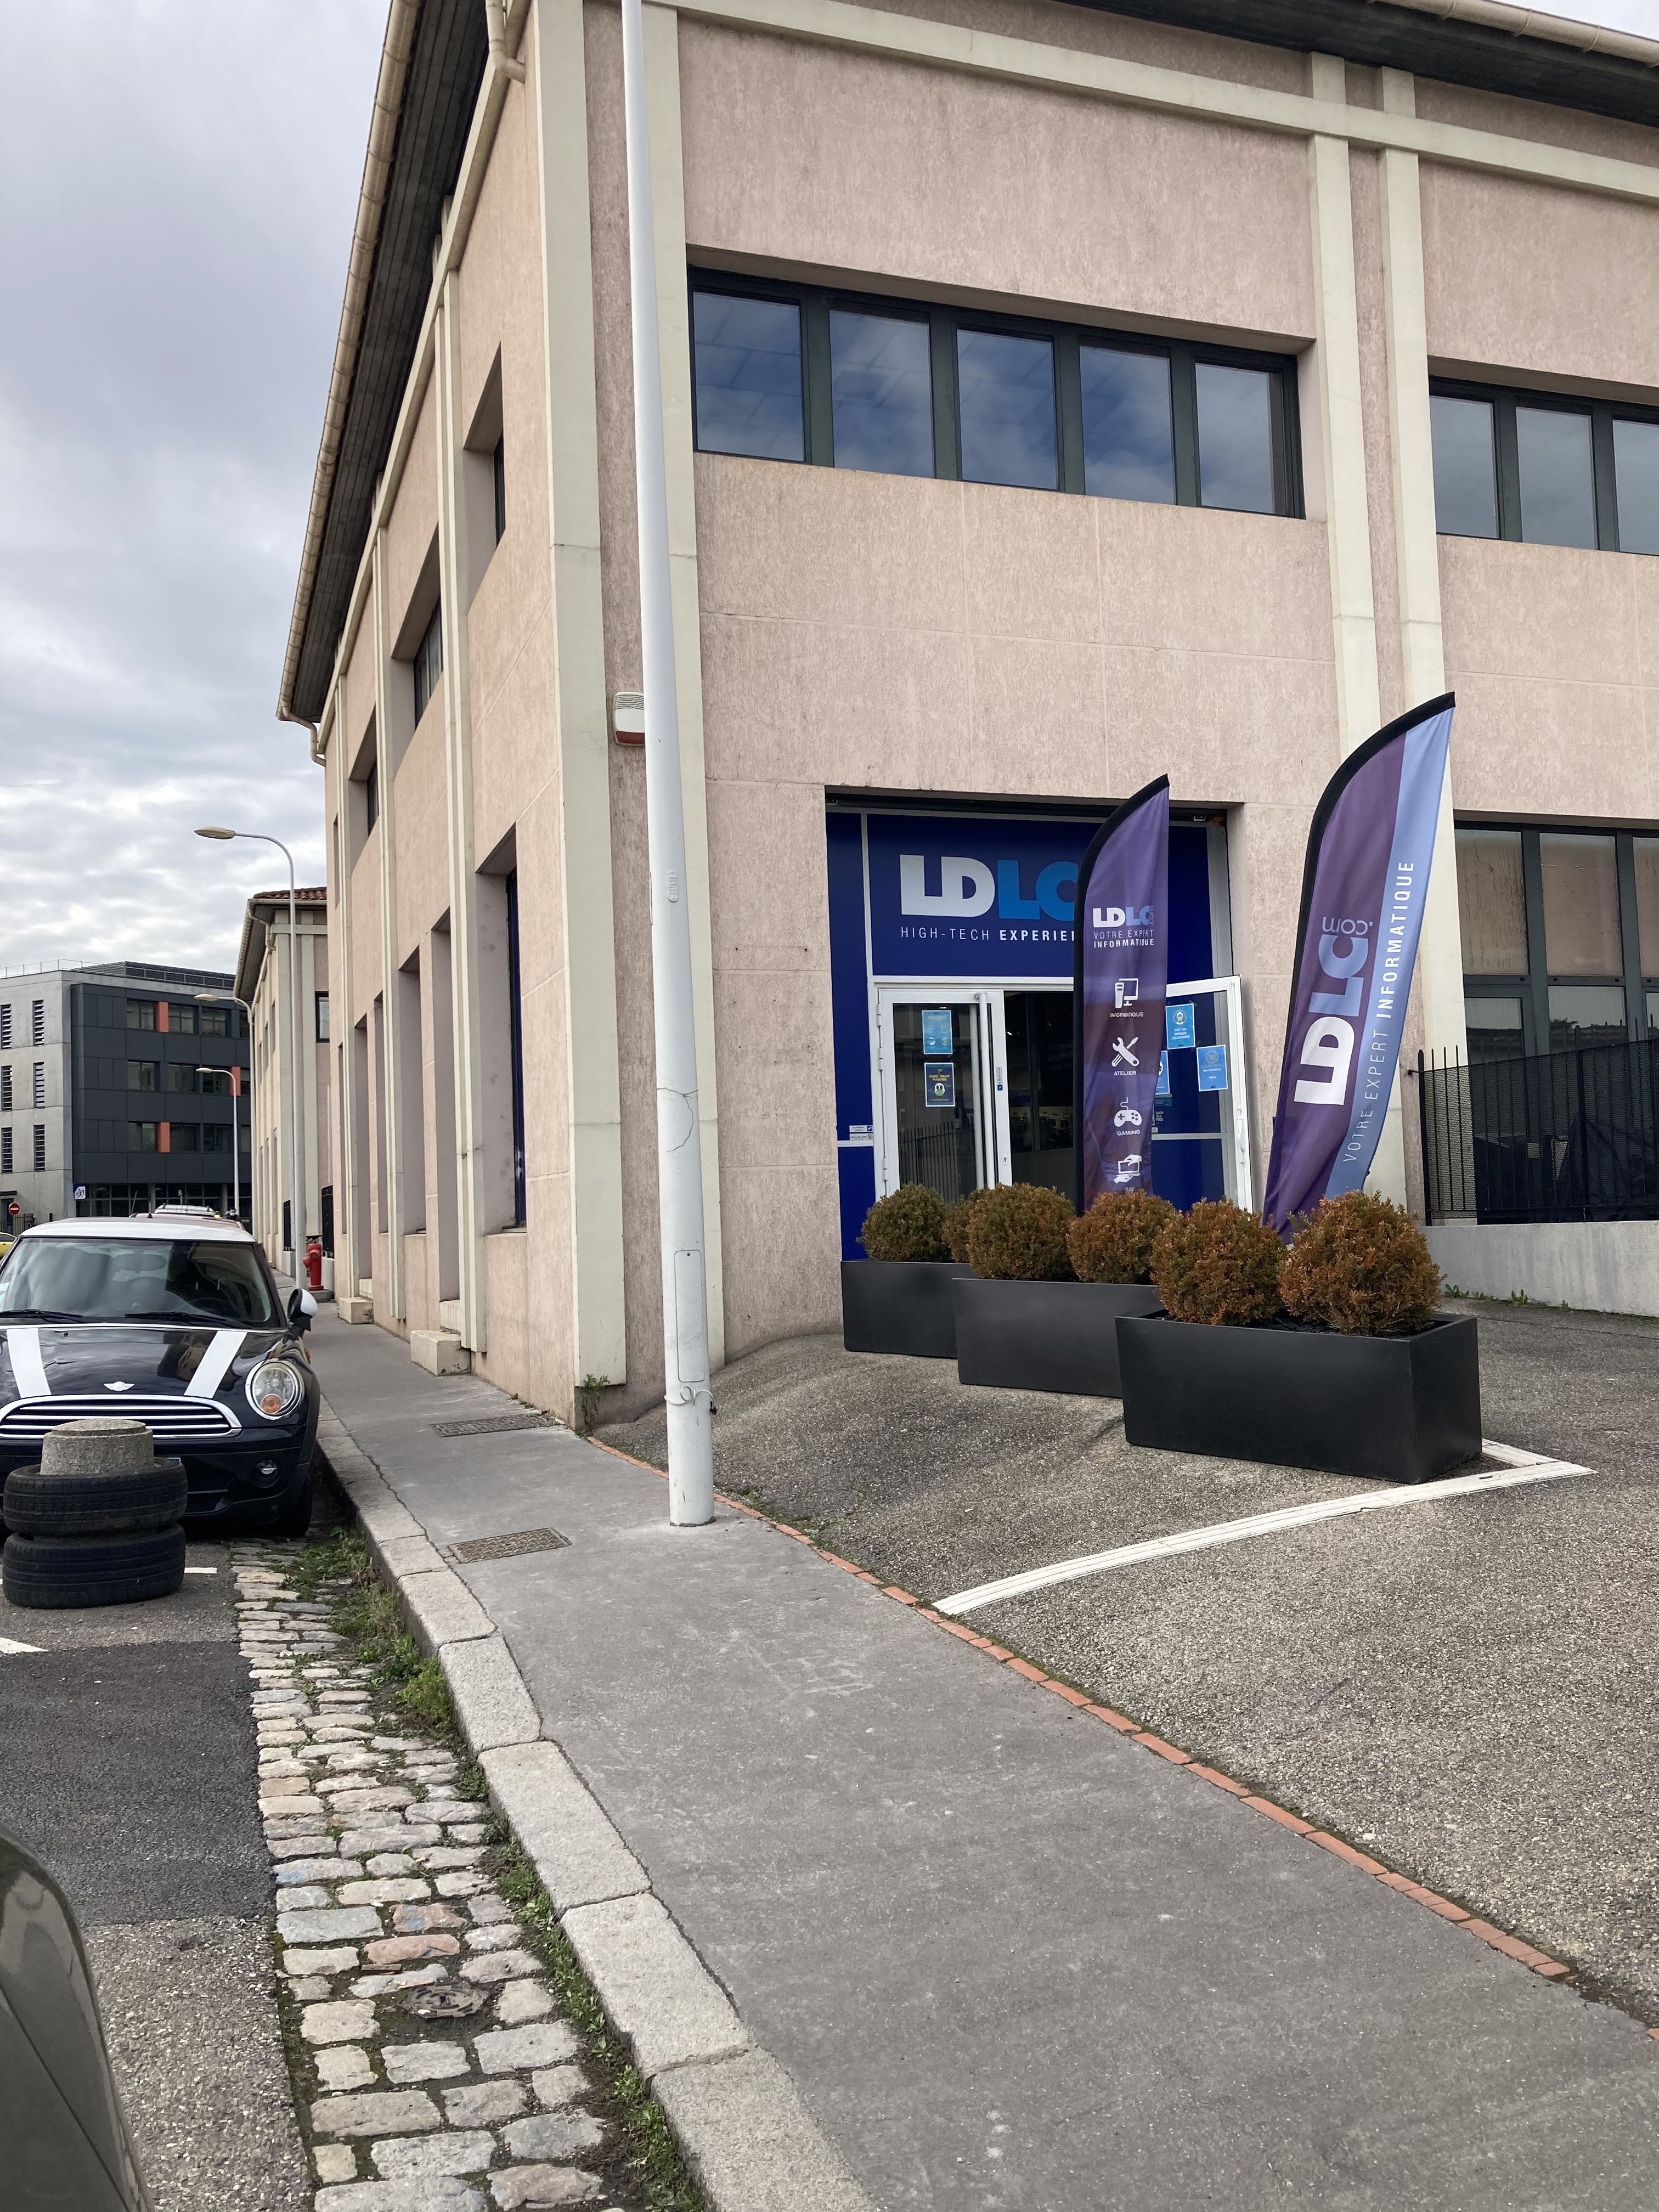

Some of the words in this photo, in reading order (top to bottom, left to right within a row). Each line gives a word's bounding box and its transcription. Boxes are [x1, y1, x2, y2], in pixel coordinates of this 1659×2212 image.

[900, 854, 1078, 921] LDLC
[901, 927, 990, 940] HIGH-TECH
[1092, 905, 1150, 928] LDLC
[1093, 930, 1122, 940] VOTRE
[1127, 929, 1154, 938] EXPERT
[1322, 917, 1373, 935] .com
[1093, 938, 1154, 948] INFORMATIQUE
[1376, 862, 1414, 1018] INFORMATIQUE
[1294, 934, 1369, 1105] LDLC
[1364, 1029, 1389, 1099] EXPERT
[1342, 1110, 1373, 1162] VOTRE
